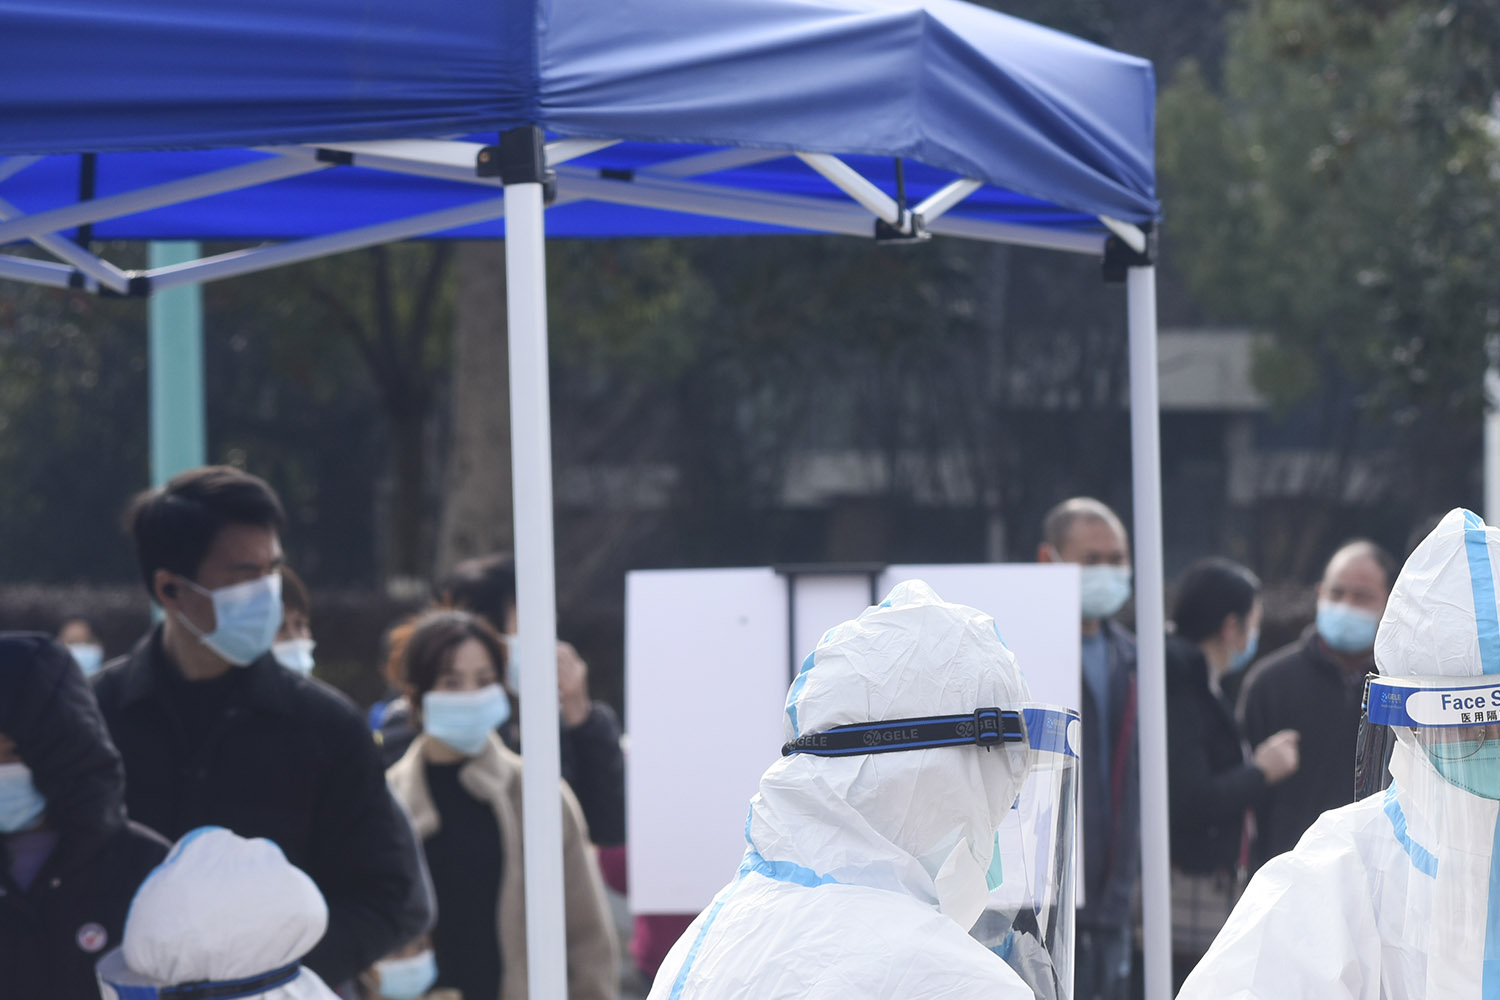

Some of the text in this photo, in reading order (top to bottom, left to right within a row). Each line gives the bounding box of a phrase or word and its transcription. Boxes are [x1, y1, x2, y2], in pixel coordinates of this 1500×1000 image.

[1441, 693, 1486, 711] Face
[882, 728, 919, 741] GELE
[797, 736, 828, 747] GELE
